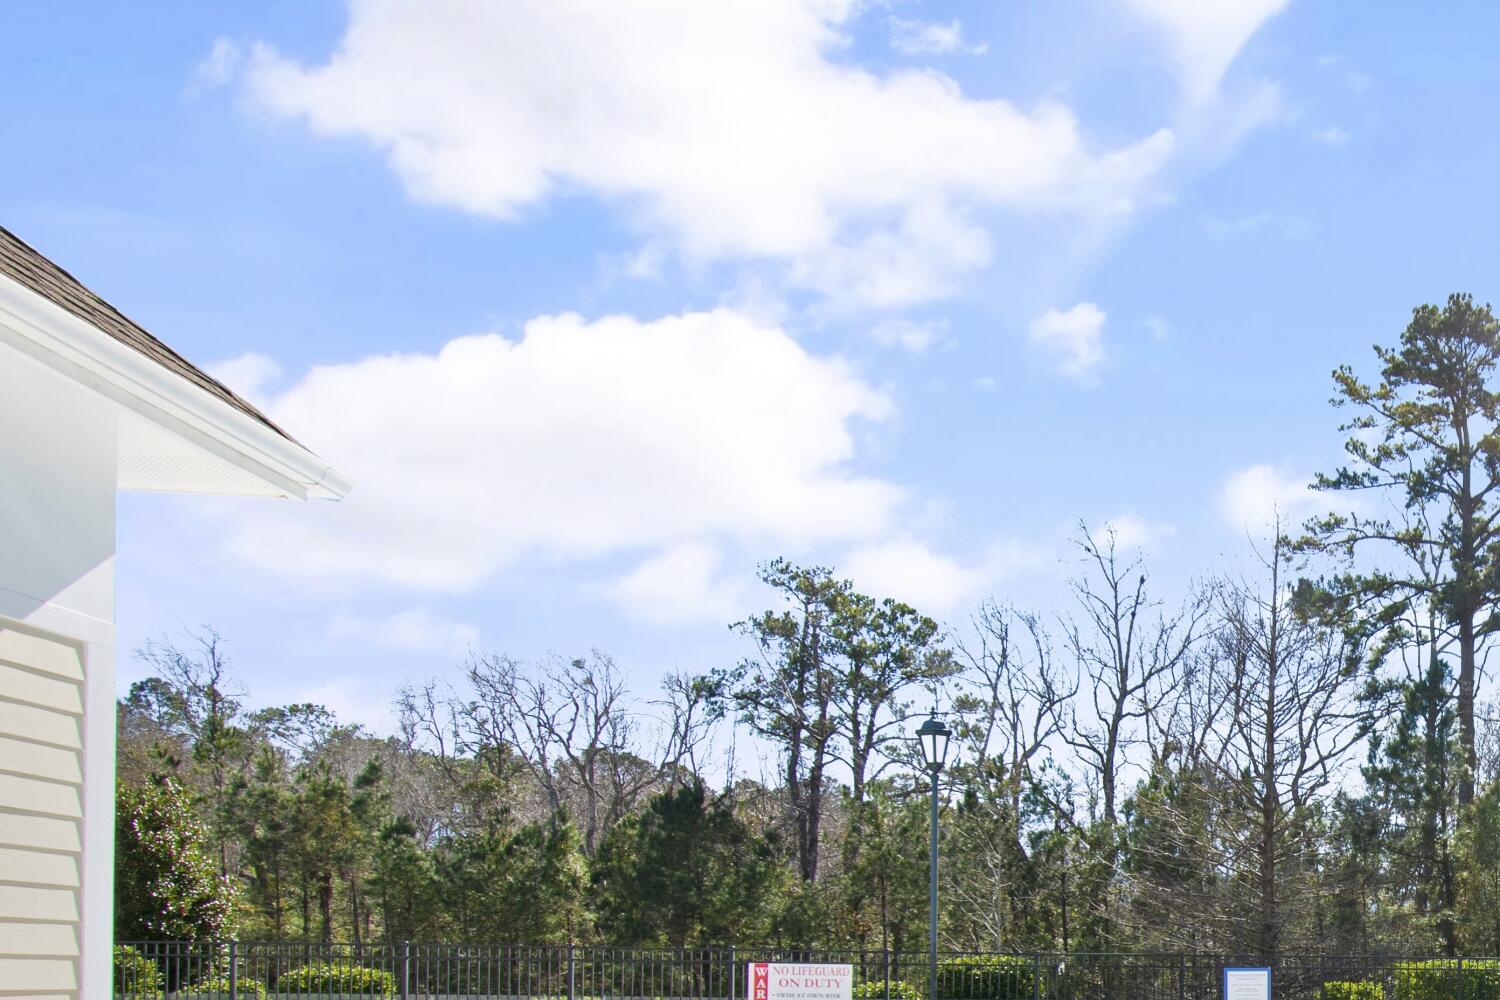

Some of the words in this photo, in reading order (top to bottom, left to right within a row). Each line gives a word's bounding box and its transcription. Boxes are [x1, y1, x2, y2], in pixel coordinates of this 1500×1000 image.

[773, 966, 789, 975] NO
[792, 966, 850, 976] LIFEGUARD
[779, 978, 800, 987] ON
[804, 978, 842, 988] DUTY
